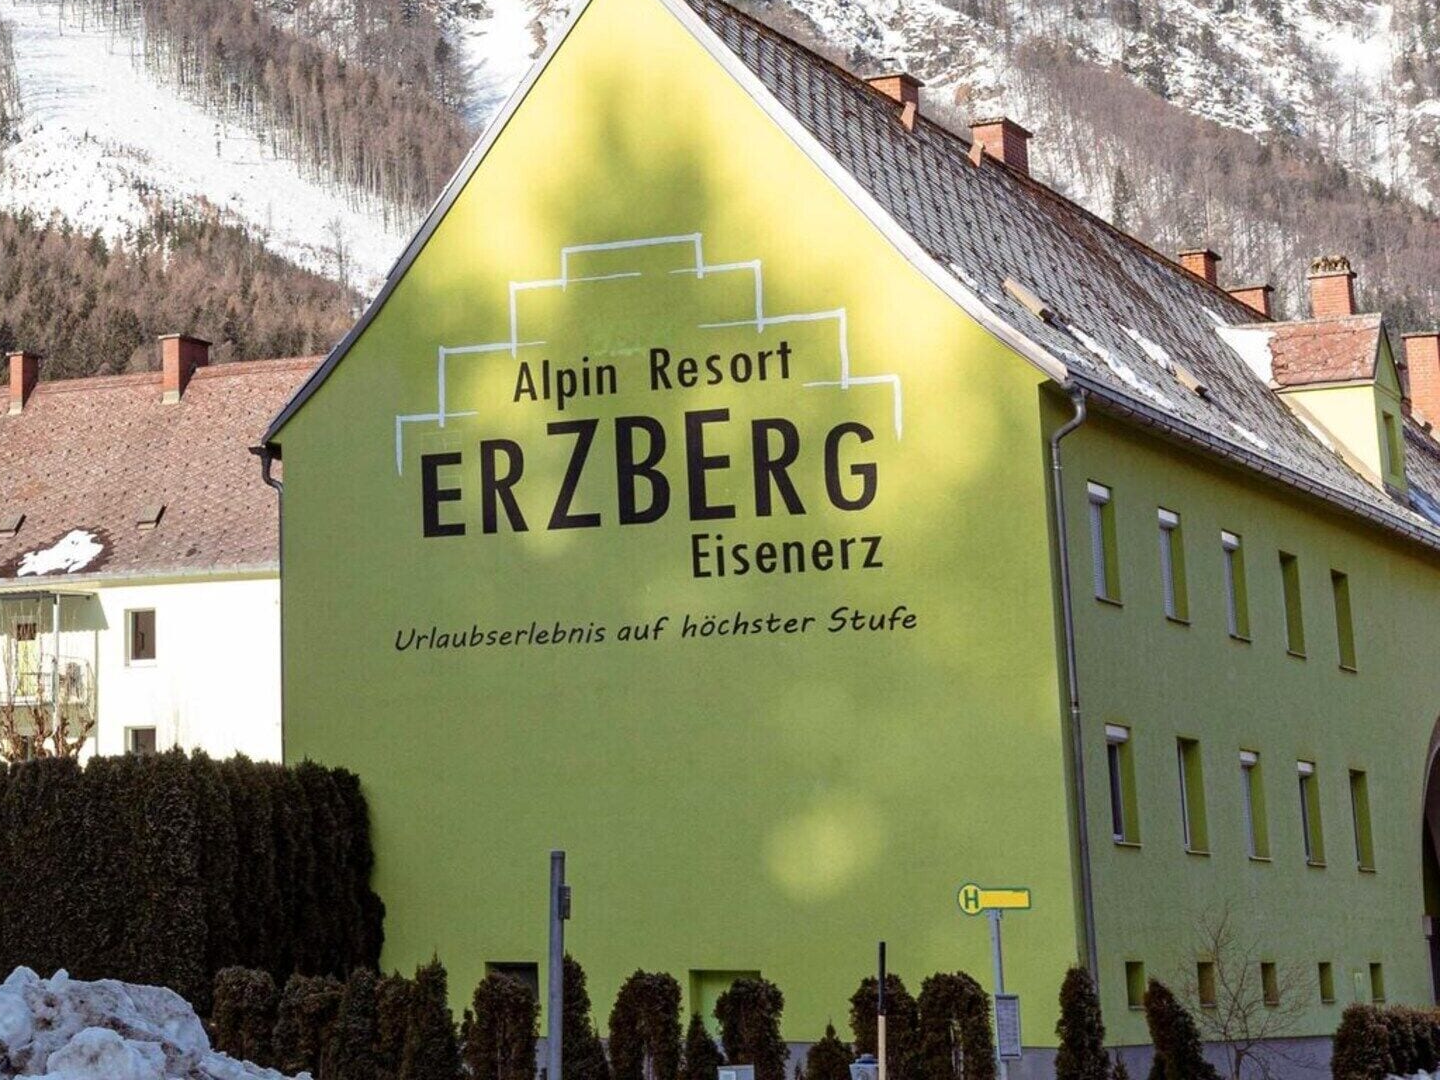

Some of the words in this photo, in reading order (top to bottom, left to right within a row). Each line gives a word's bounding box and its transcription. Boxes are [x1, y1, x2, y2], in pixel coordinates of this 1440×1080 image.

[513, 359, 618, 410] Alpin
[649, 341, 793, 391] Resort
[420, 408, 879, 538] ERZBERG
[691, 533, 883, 578] Eisenerz
[394, 620, 606, 652] Urlaubserlebnis
[616, 616, 669, 641] auf
[681, 610, 816, 638] höchster
[827, 605, 918, 633] Stufe
[964, 889, 979, 909] H
